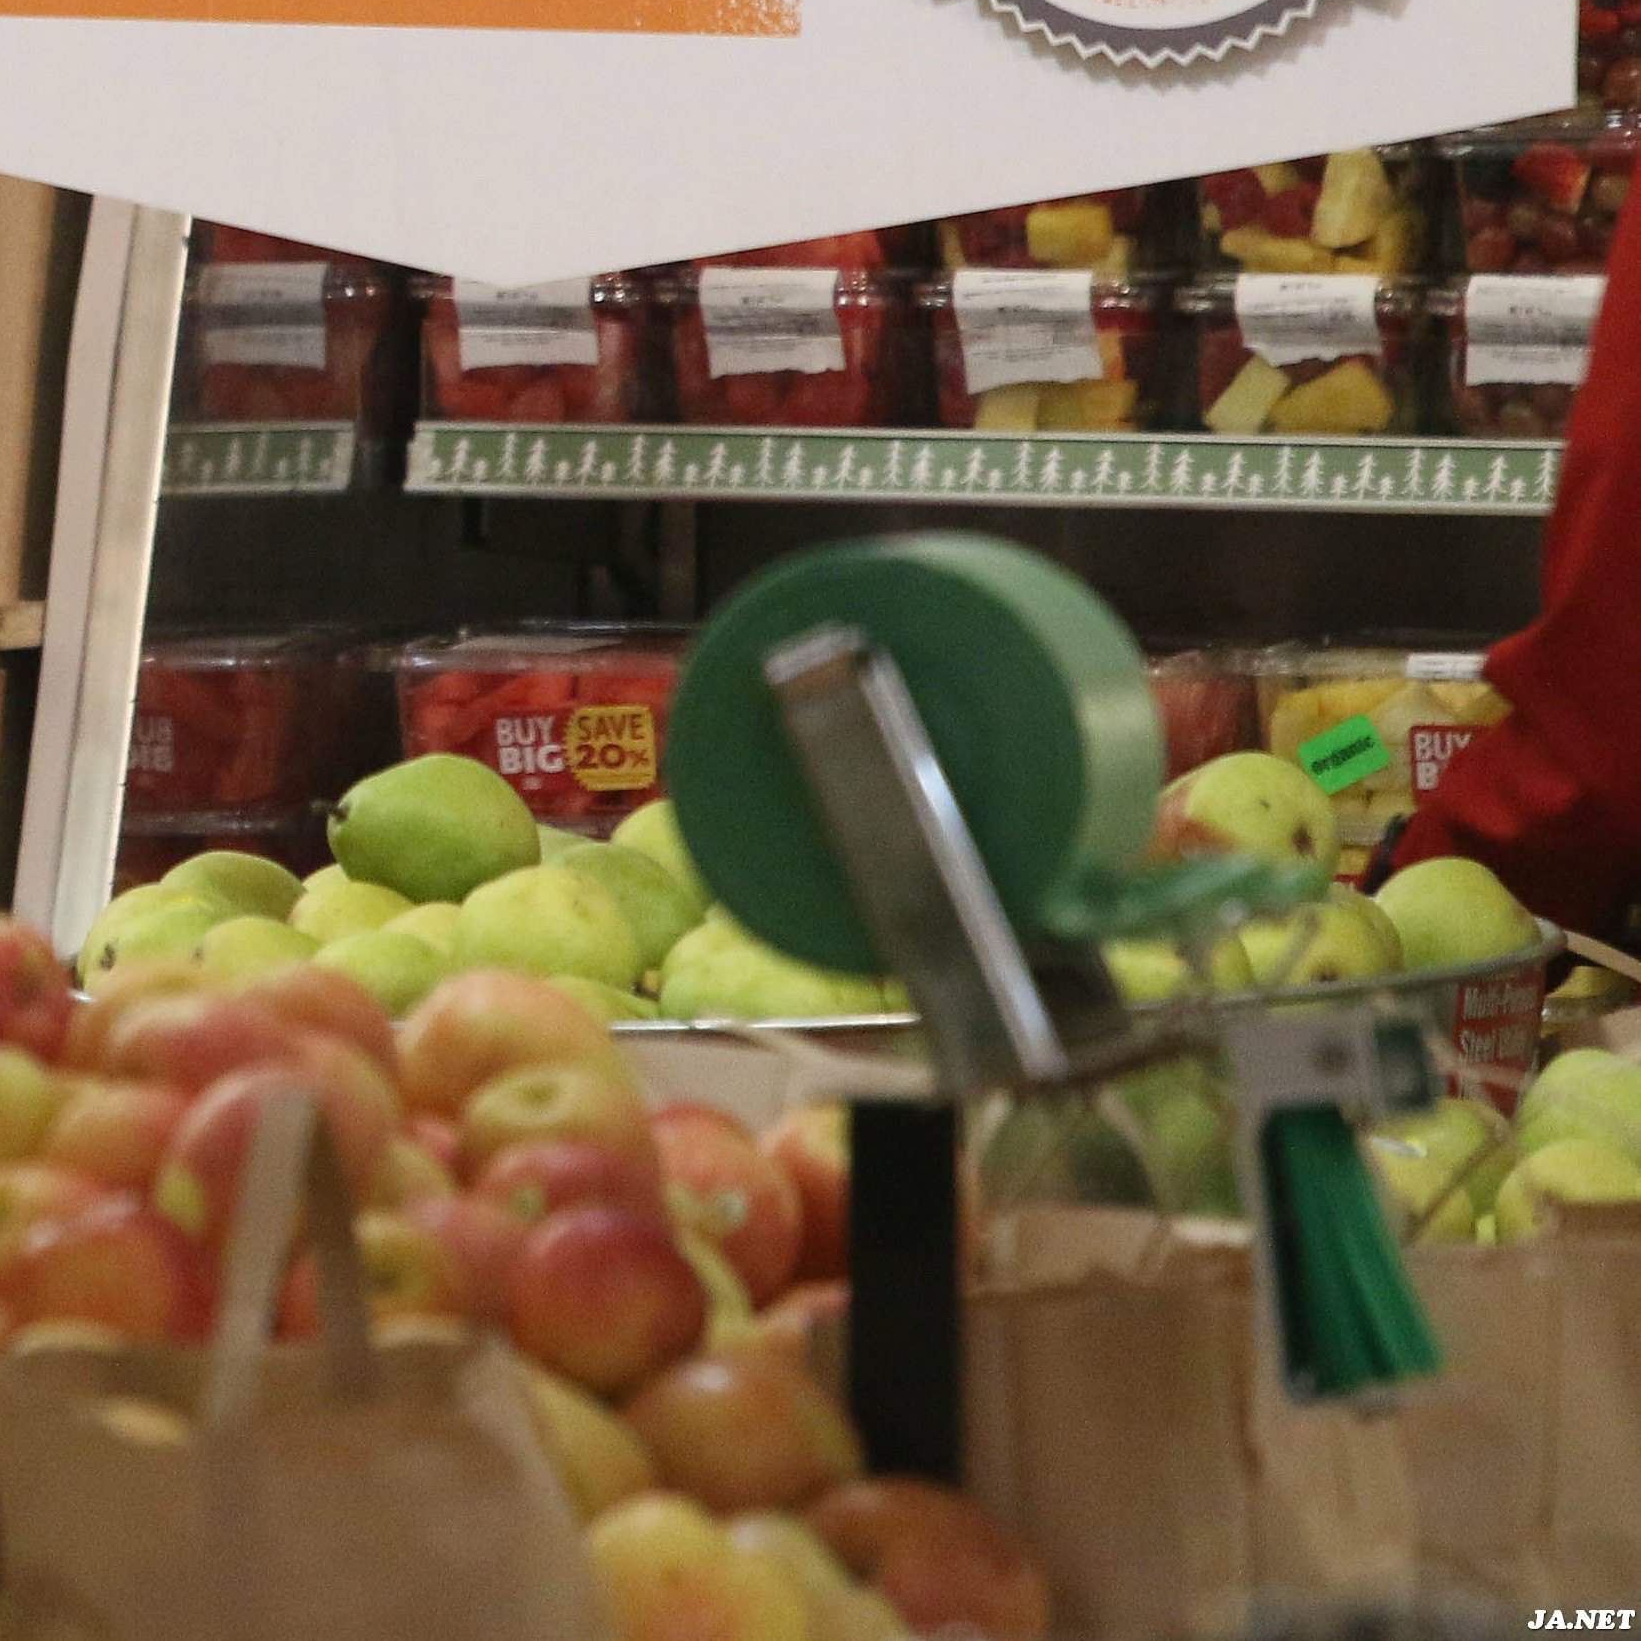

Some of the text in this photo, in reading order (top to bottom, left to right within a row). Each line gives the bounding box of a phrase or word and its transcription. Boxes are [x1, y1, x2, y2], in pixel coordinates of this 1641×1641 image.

[496, 716, 555, 745] BUY
[577, 713, 646, 741] SAVE
[498, 744, 565, 775] BIG
[575, 743, 649, 769] 20%
